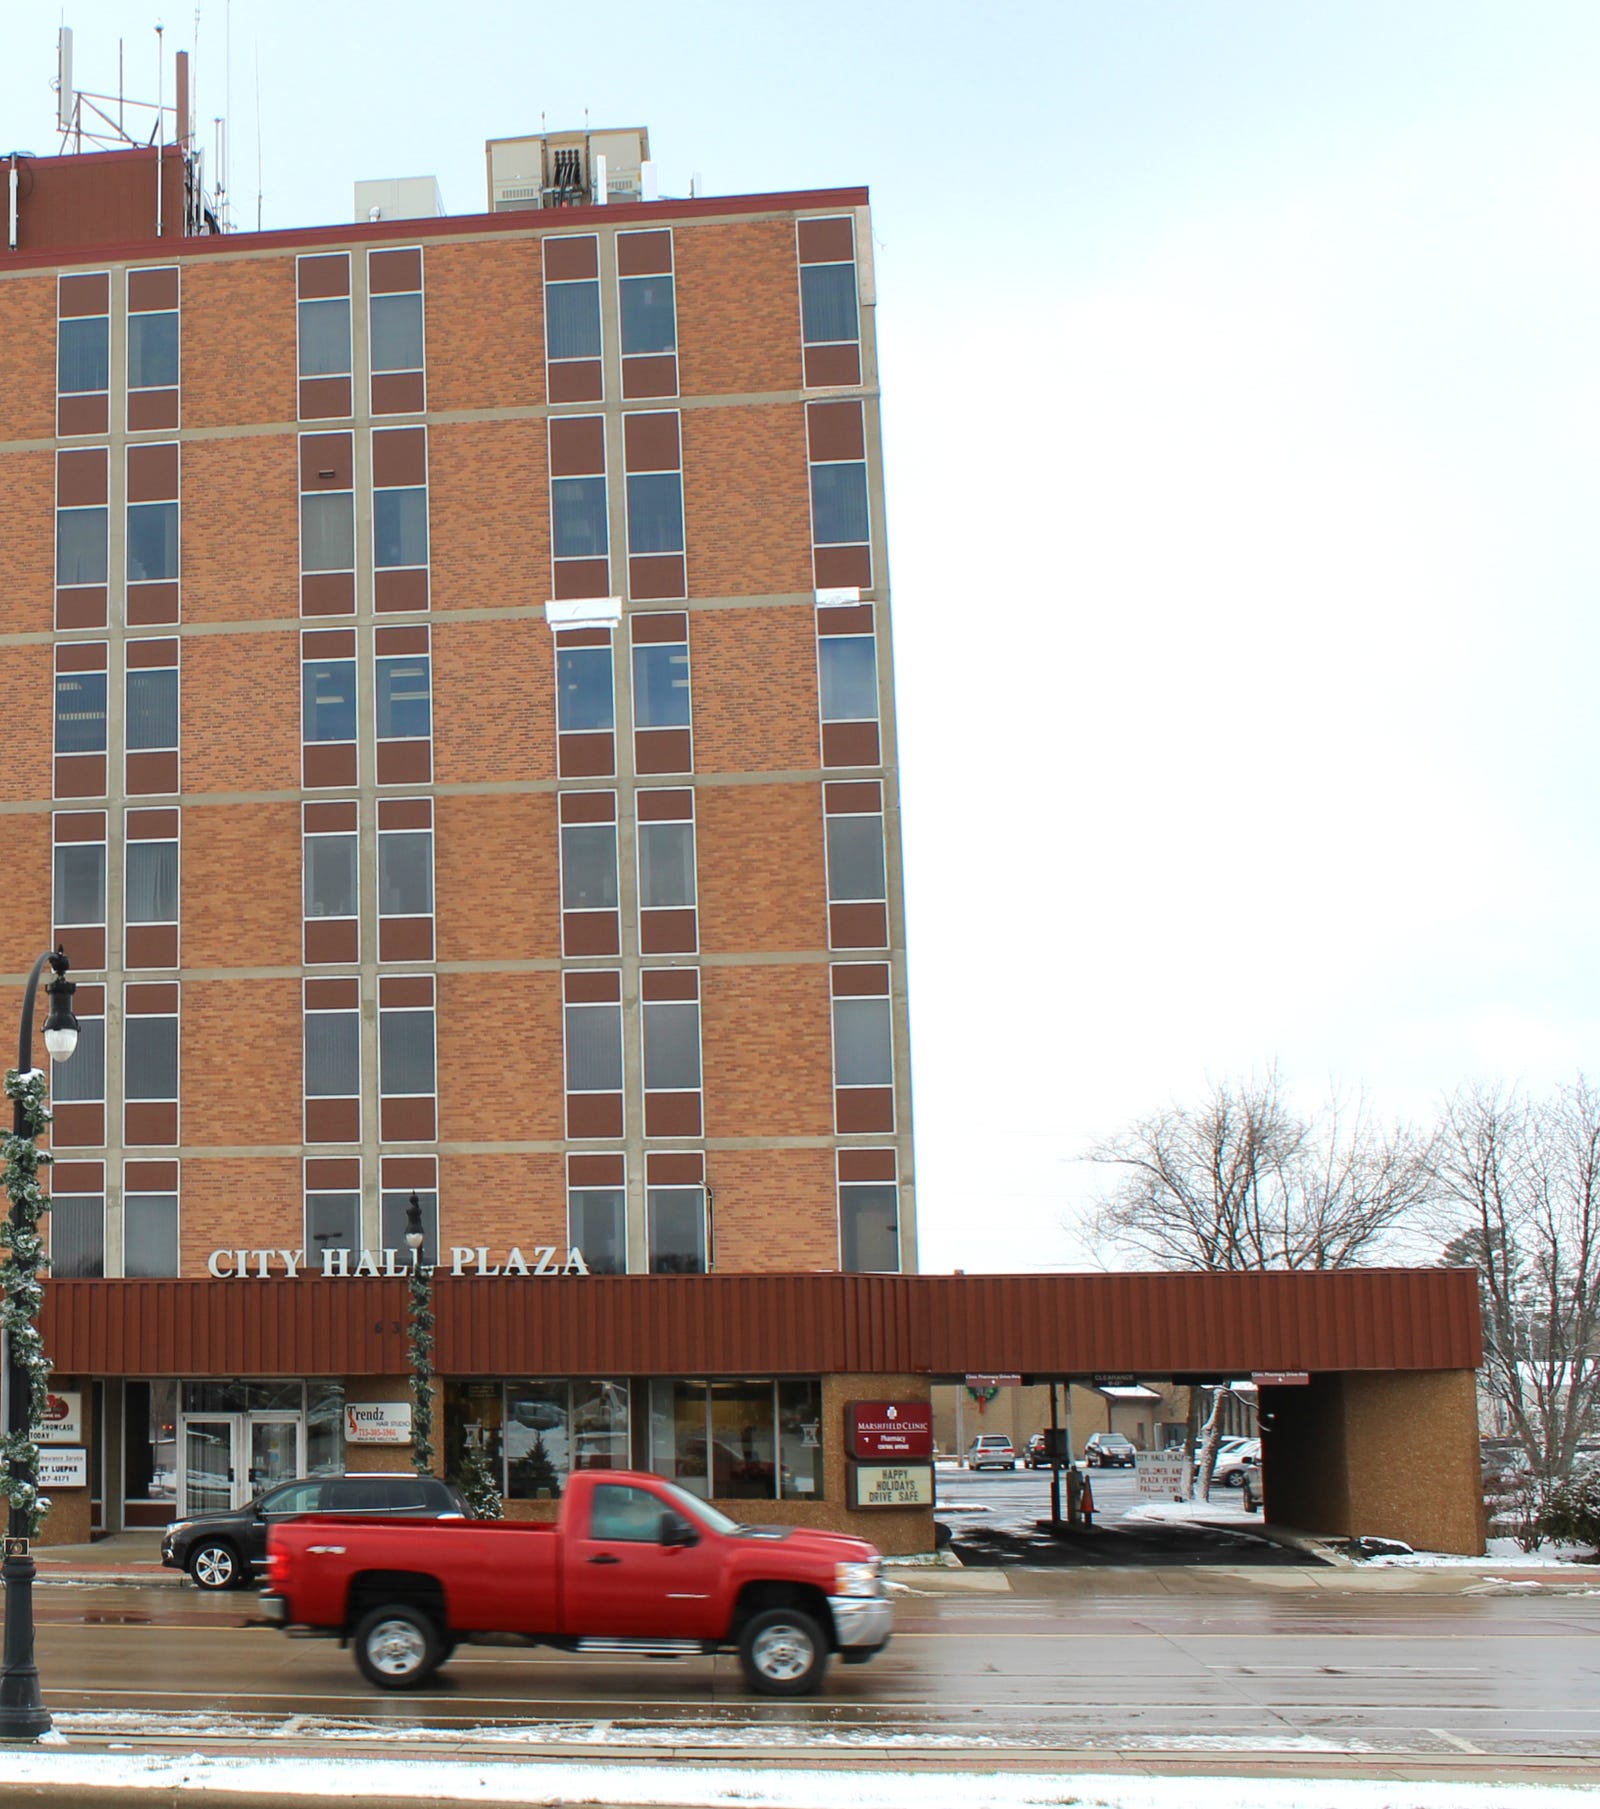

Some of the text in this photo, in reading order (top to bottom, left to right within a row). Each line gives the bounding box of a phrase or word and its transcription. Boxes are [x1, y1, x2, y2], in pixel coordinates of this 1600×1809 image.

[208, 1249, 303, 1279] CITY
[450, 1247, 590, 1277] PLAZA
[347, 1406, 384, 1428] Trendz
[42, 1424, 74, 1432] SHOWCASE
[858, 1422, 928, 1430] MARSHFIELD CLINIC
[880, 1435, 906, 1443] Pharmacy
[882, 1470, 908, 1480] HAPPY
[876, 1480, 916, 1491] HOLIDAYS
[869, 1491, 919, 1502] DRIVE SAFE
